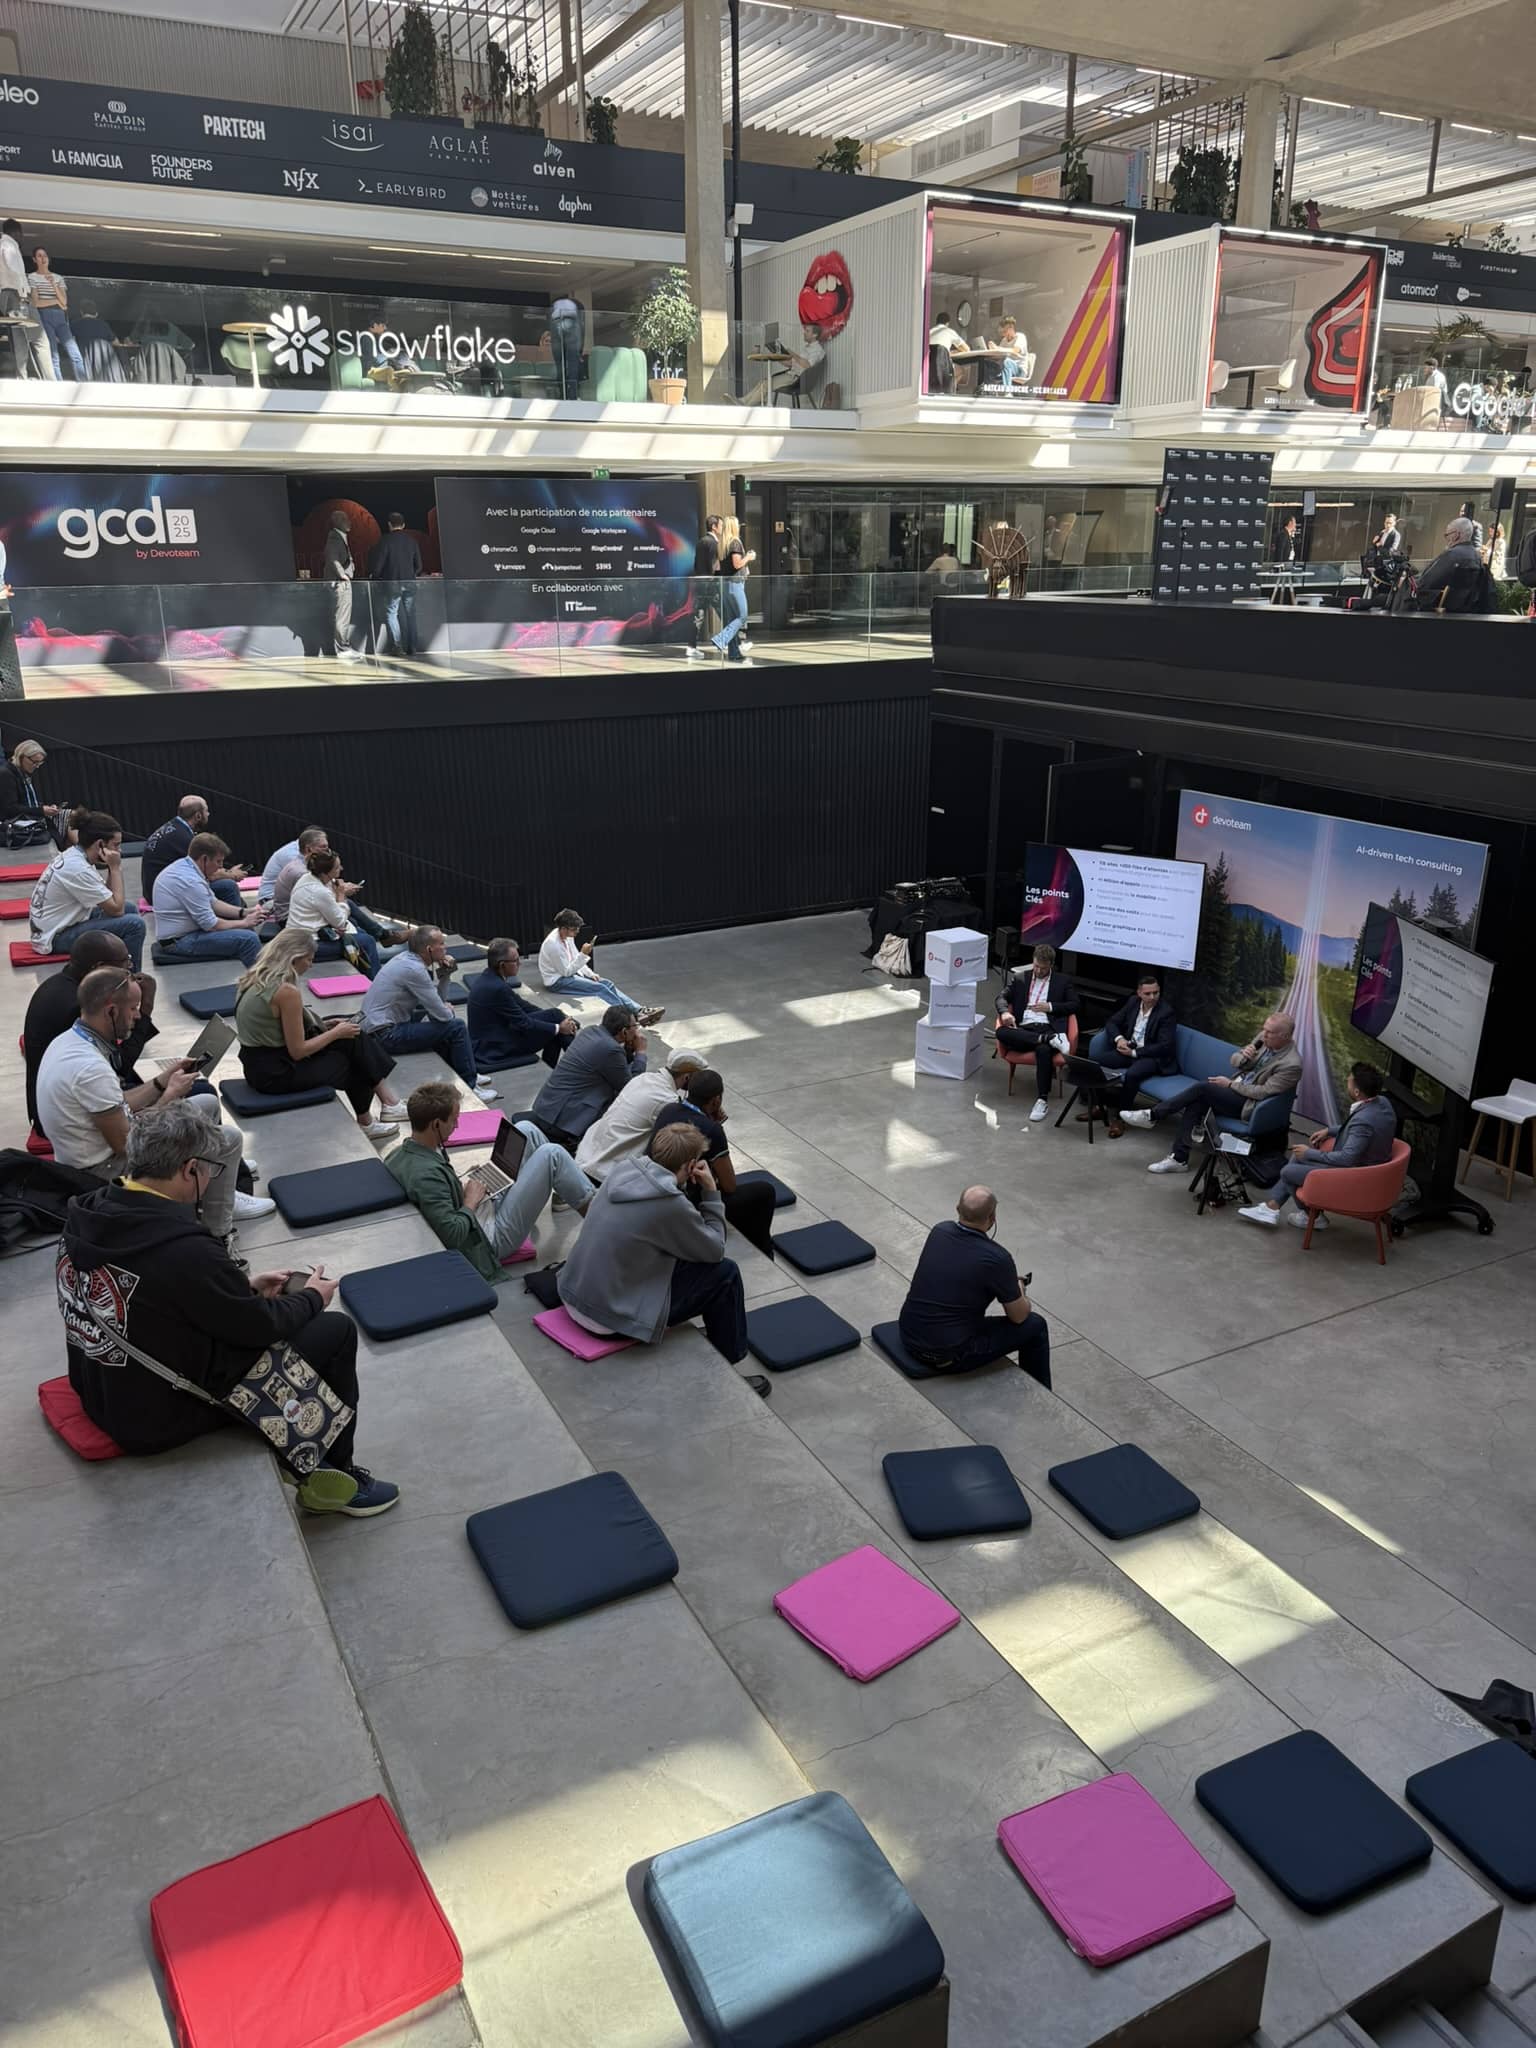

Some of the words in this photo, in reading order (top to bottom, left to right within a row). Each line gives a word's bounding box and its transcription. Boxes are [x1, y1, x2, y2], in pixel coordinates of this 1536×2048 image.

[94, 112, 146, 126] PALADIN
[203, 114, 266, 141] PARTECH
[331, 119, 373, 143] isai
[429, 135, 490, 156] AGLAÉ
[52, 149, 66, 163] LA
[68, 150, 124, 169] FAMIGLIA
[151, 154, 213, 171] FOUNDERS
[152, 166, 194, 181] FUTURE
[533, 161, 575, 179] alven
[376, 182, 446, 199] EARLYBIRD
[491, 190, 528, 202] Motier
[492, 201, 540, 212] ventures
[558, 194, 592, 218] daphni
[336, 325, 516, 364] snowflake
[172, 515, 189, 526] 20
[486, 508, 508, 517] Avec
[510, 507, 519, 517] la
[520, 508, 577, 519] participation
[579, 507, 590, 517] de
[592, 509, 608, 517] nos
[610, 508, 657, 519] partenaires
[57, 496, 166, 559] gcd
[174, 527, 191, 538] 25
[136, 548, 148, 560] by
[151, 549, 200, 558] Devoteam
[532, 584, 544, 592] En
[545, 583, 602, 592] collaboration
[603, 584, 624, 592] avec
[1356, 845, 1394, 860] AI-driven
[1395, 853, 1414, 864] tech
[1415, 858, 1463, 876] consulting
[1025, 885, 1041, 894] Les
[1042, 889, 1070, 899] points
[1025, 895, 1043, 904] Clés
